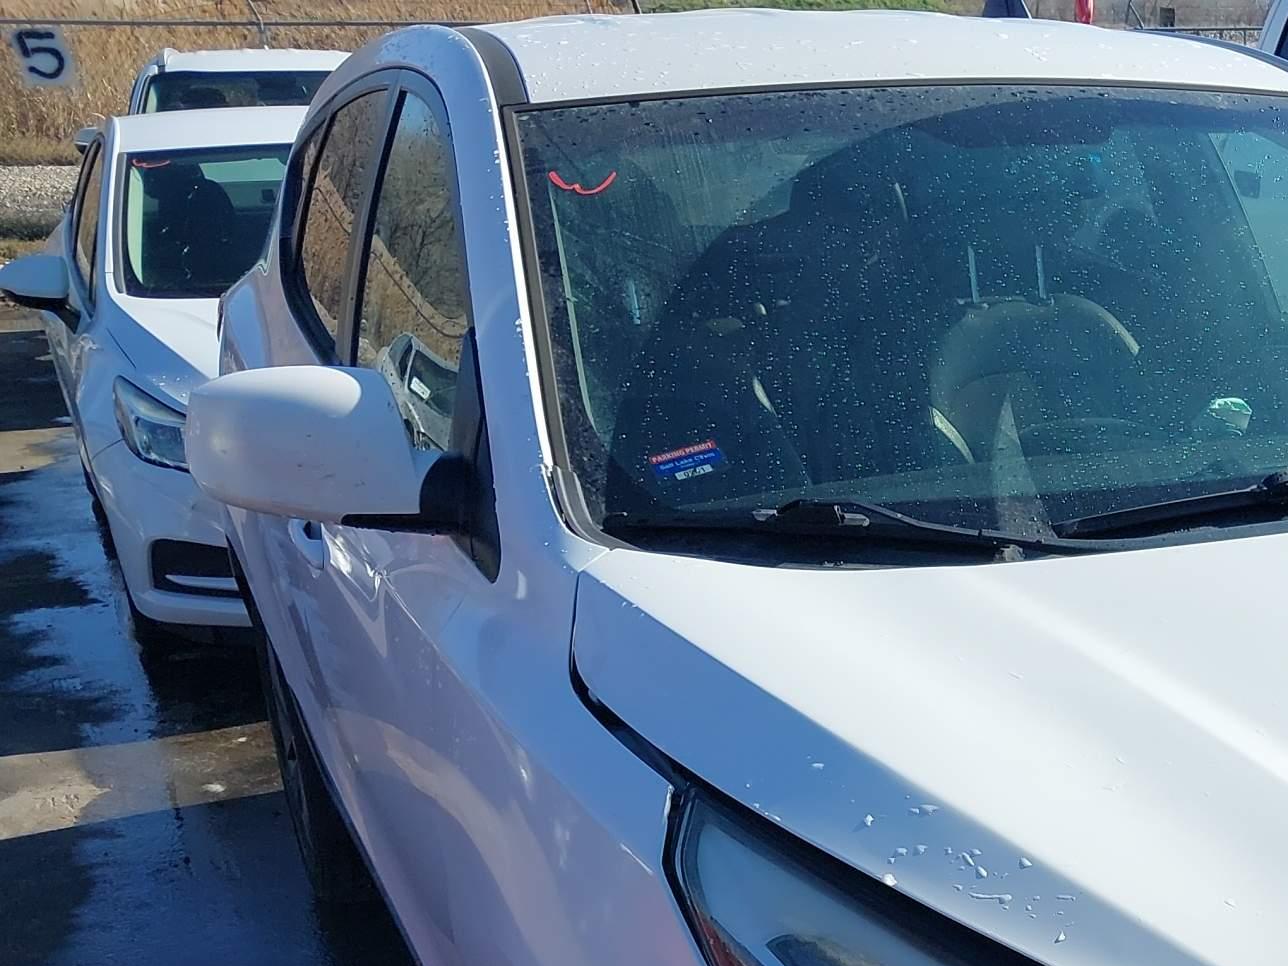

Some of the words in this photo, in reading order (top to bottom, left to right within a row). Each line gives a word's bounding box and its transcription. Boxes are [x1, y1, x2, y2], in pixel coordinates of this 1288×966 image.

[16, 31, 65, 79] 5
[650, 448, 685, 463] PARKING
[685, 441, 712, 454] PERMIT
